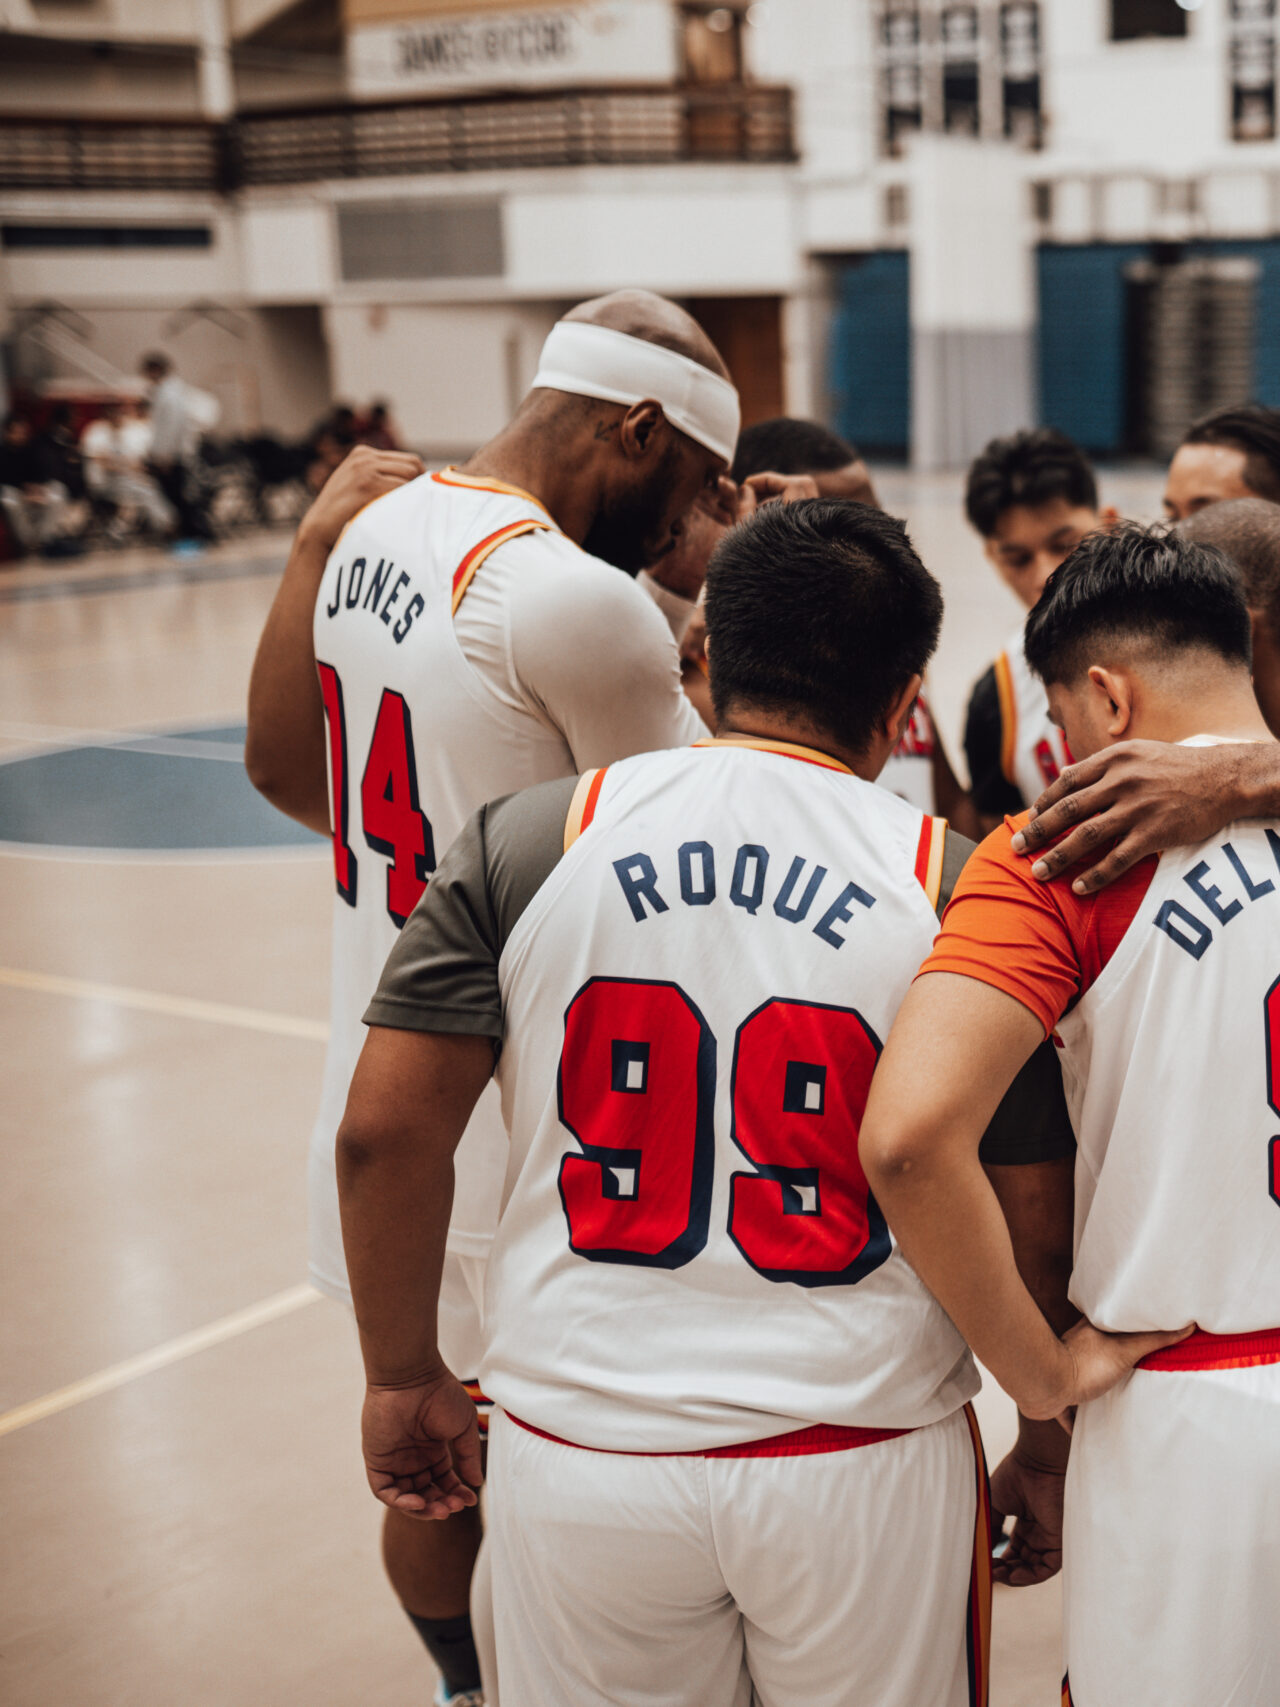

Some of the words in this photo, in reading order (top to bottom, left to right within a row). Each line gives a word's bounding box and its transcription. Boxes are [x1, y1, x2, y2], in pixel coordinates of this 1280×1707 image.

[327, 556, 425, 645] JONES
[612, 840, 877, 950] ROQUE
[557, 975, 893, 1288] 99
